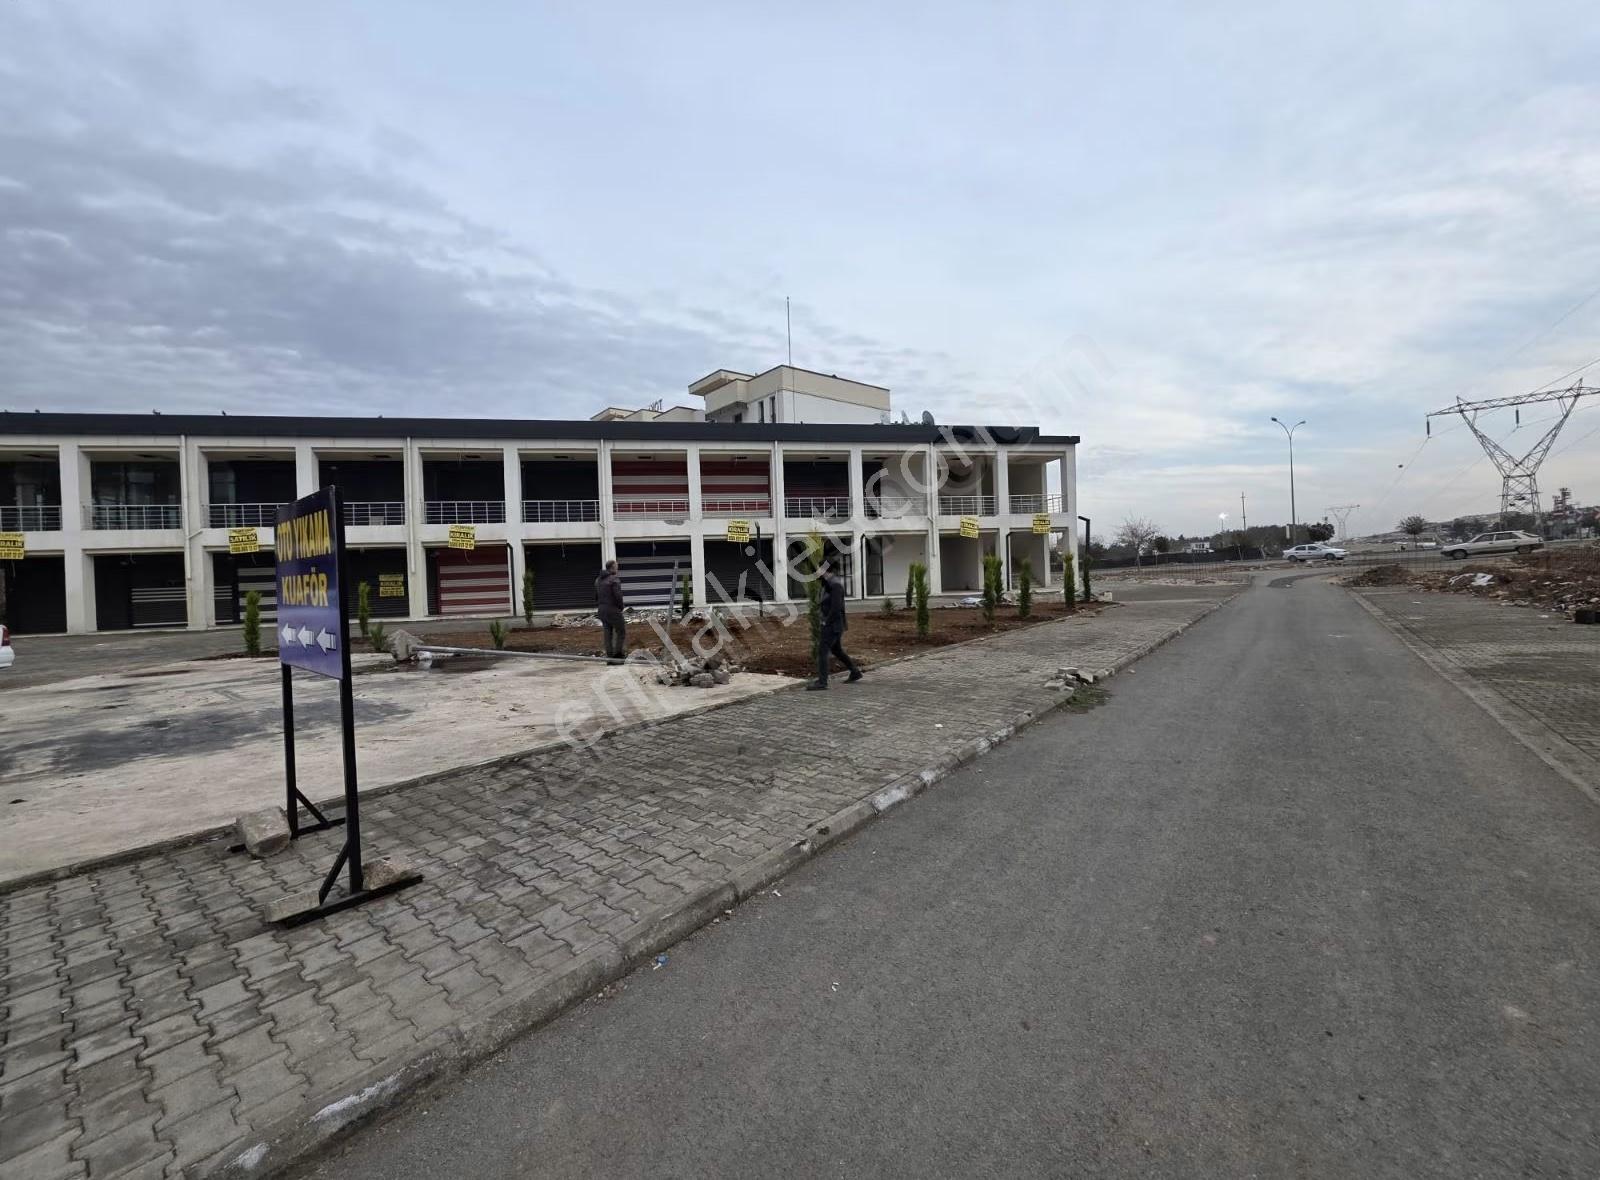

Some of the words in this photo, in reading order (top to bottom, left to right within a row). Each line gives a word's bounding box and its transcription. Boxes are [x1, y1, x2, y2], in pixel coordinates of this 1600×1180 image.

[277, 520, 293, 562] OTO
[293, 508, 331, 559] YIKAMA
[282, 567, 328, 607] KUAFÖR
